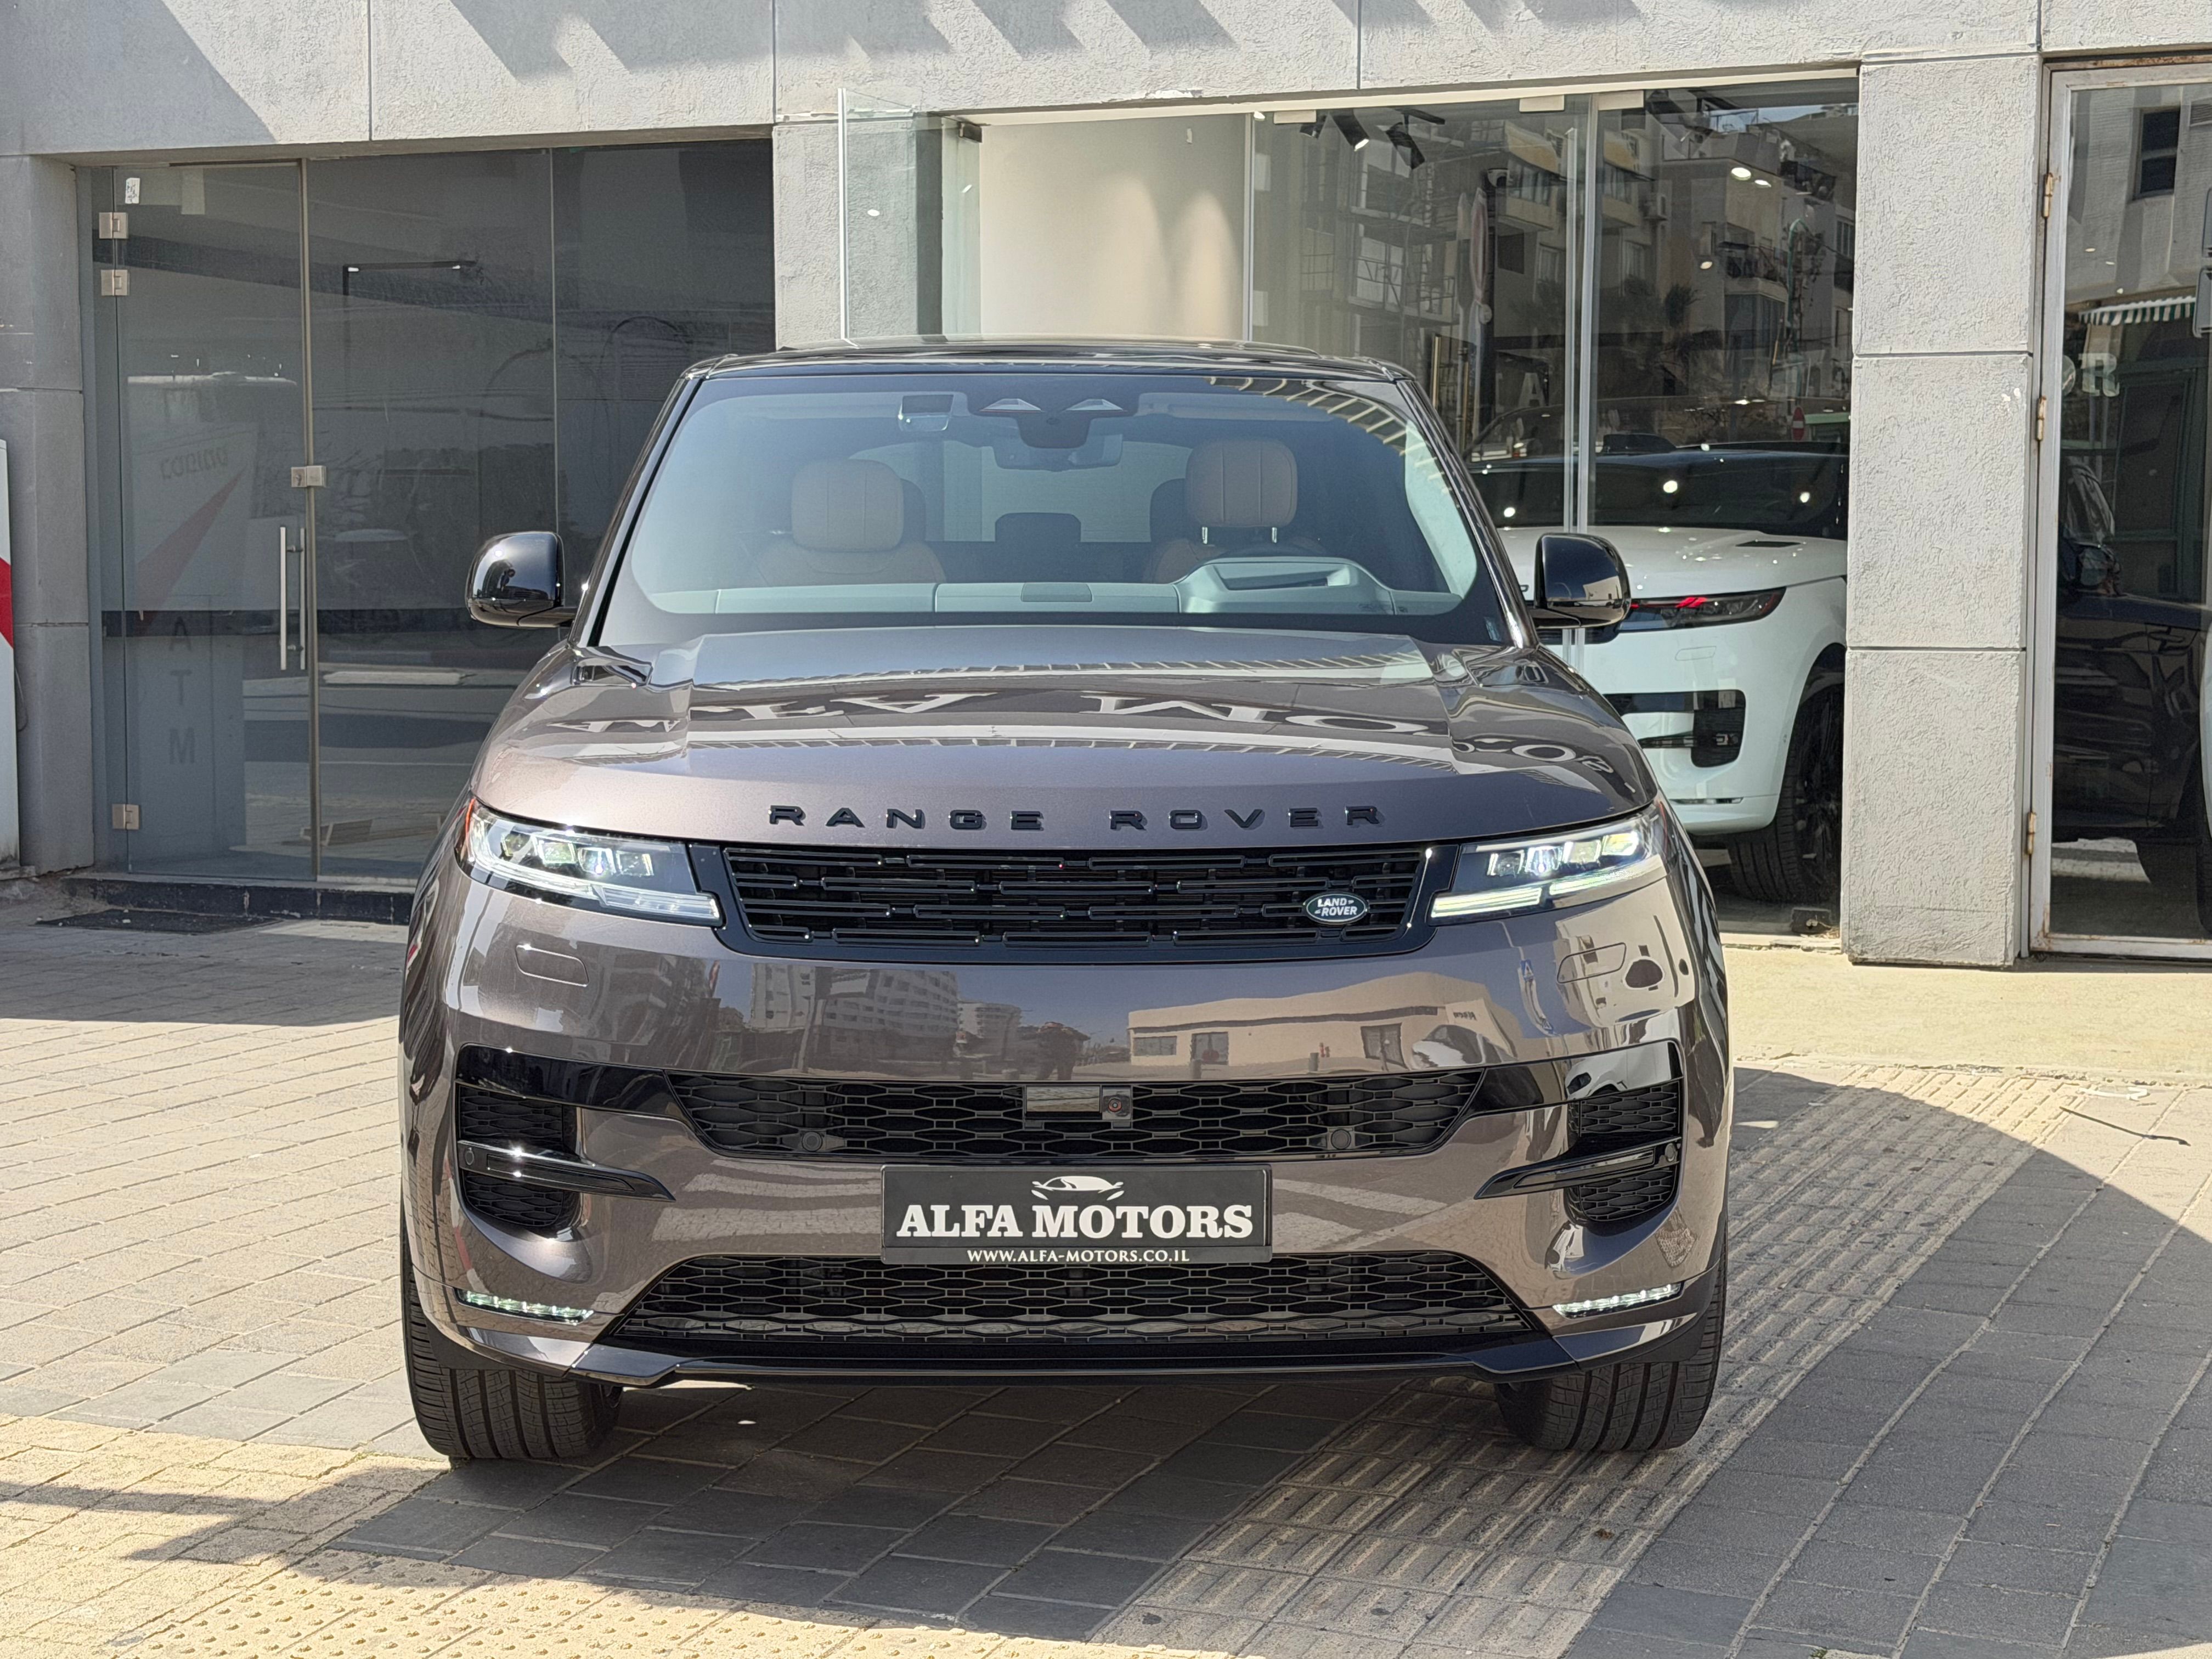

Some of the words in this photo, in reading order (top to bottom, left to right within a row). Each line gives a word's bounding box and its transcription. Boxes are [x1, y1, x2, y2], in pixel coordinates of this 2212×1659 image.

[769, 805, 1045, 831] RANGE
[1109, 805, 1381, 830] ROVER
[1317, 898, 1347, 907] LAND
[1321, 906, 1358, 917] ROVER
[896, 1205, 1023, 1238] ALFA
[1032, 1205, 1253, 1239] MOTORS
[967, 1249, 1190, 1263] WWW.ALFA-MOTORS.CO.IL
